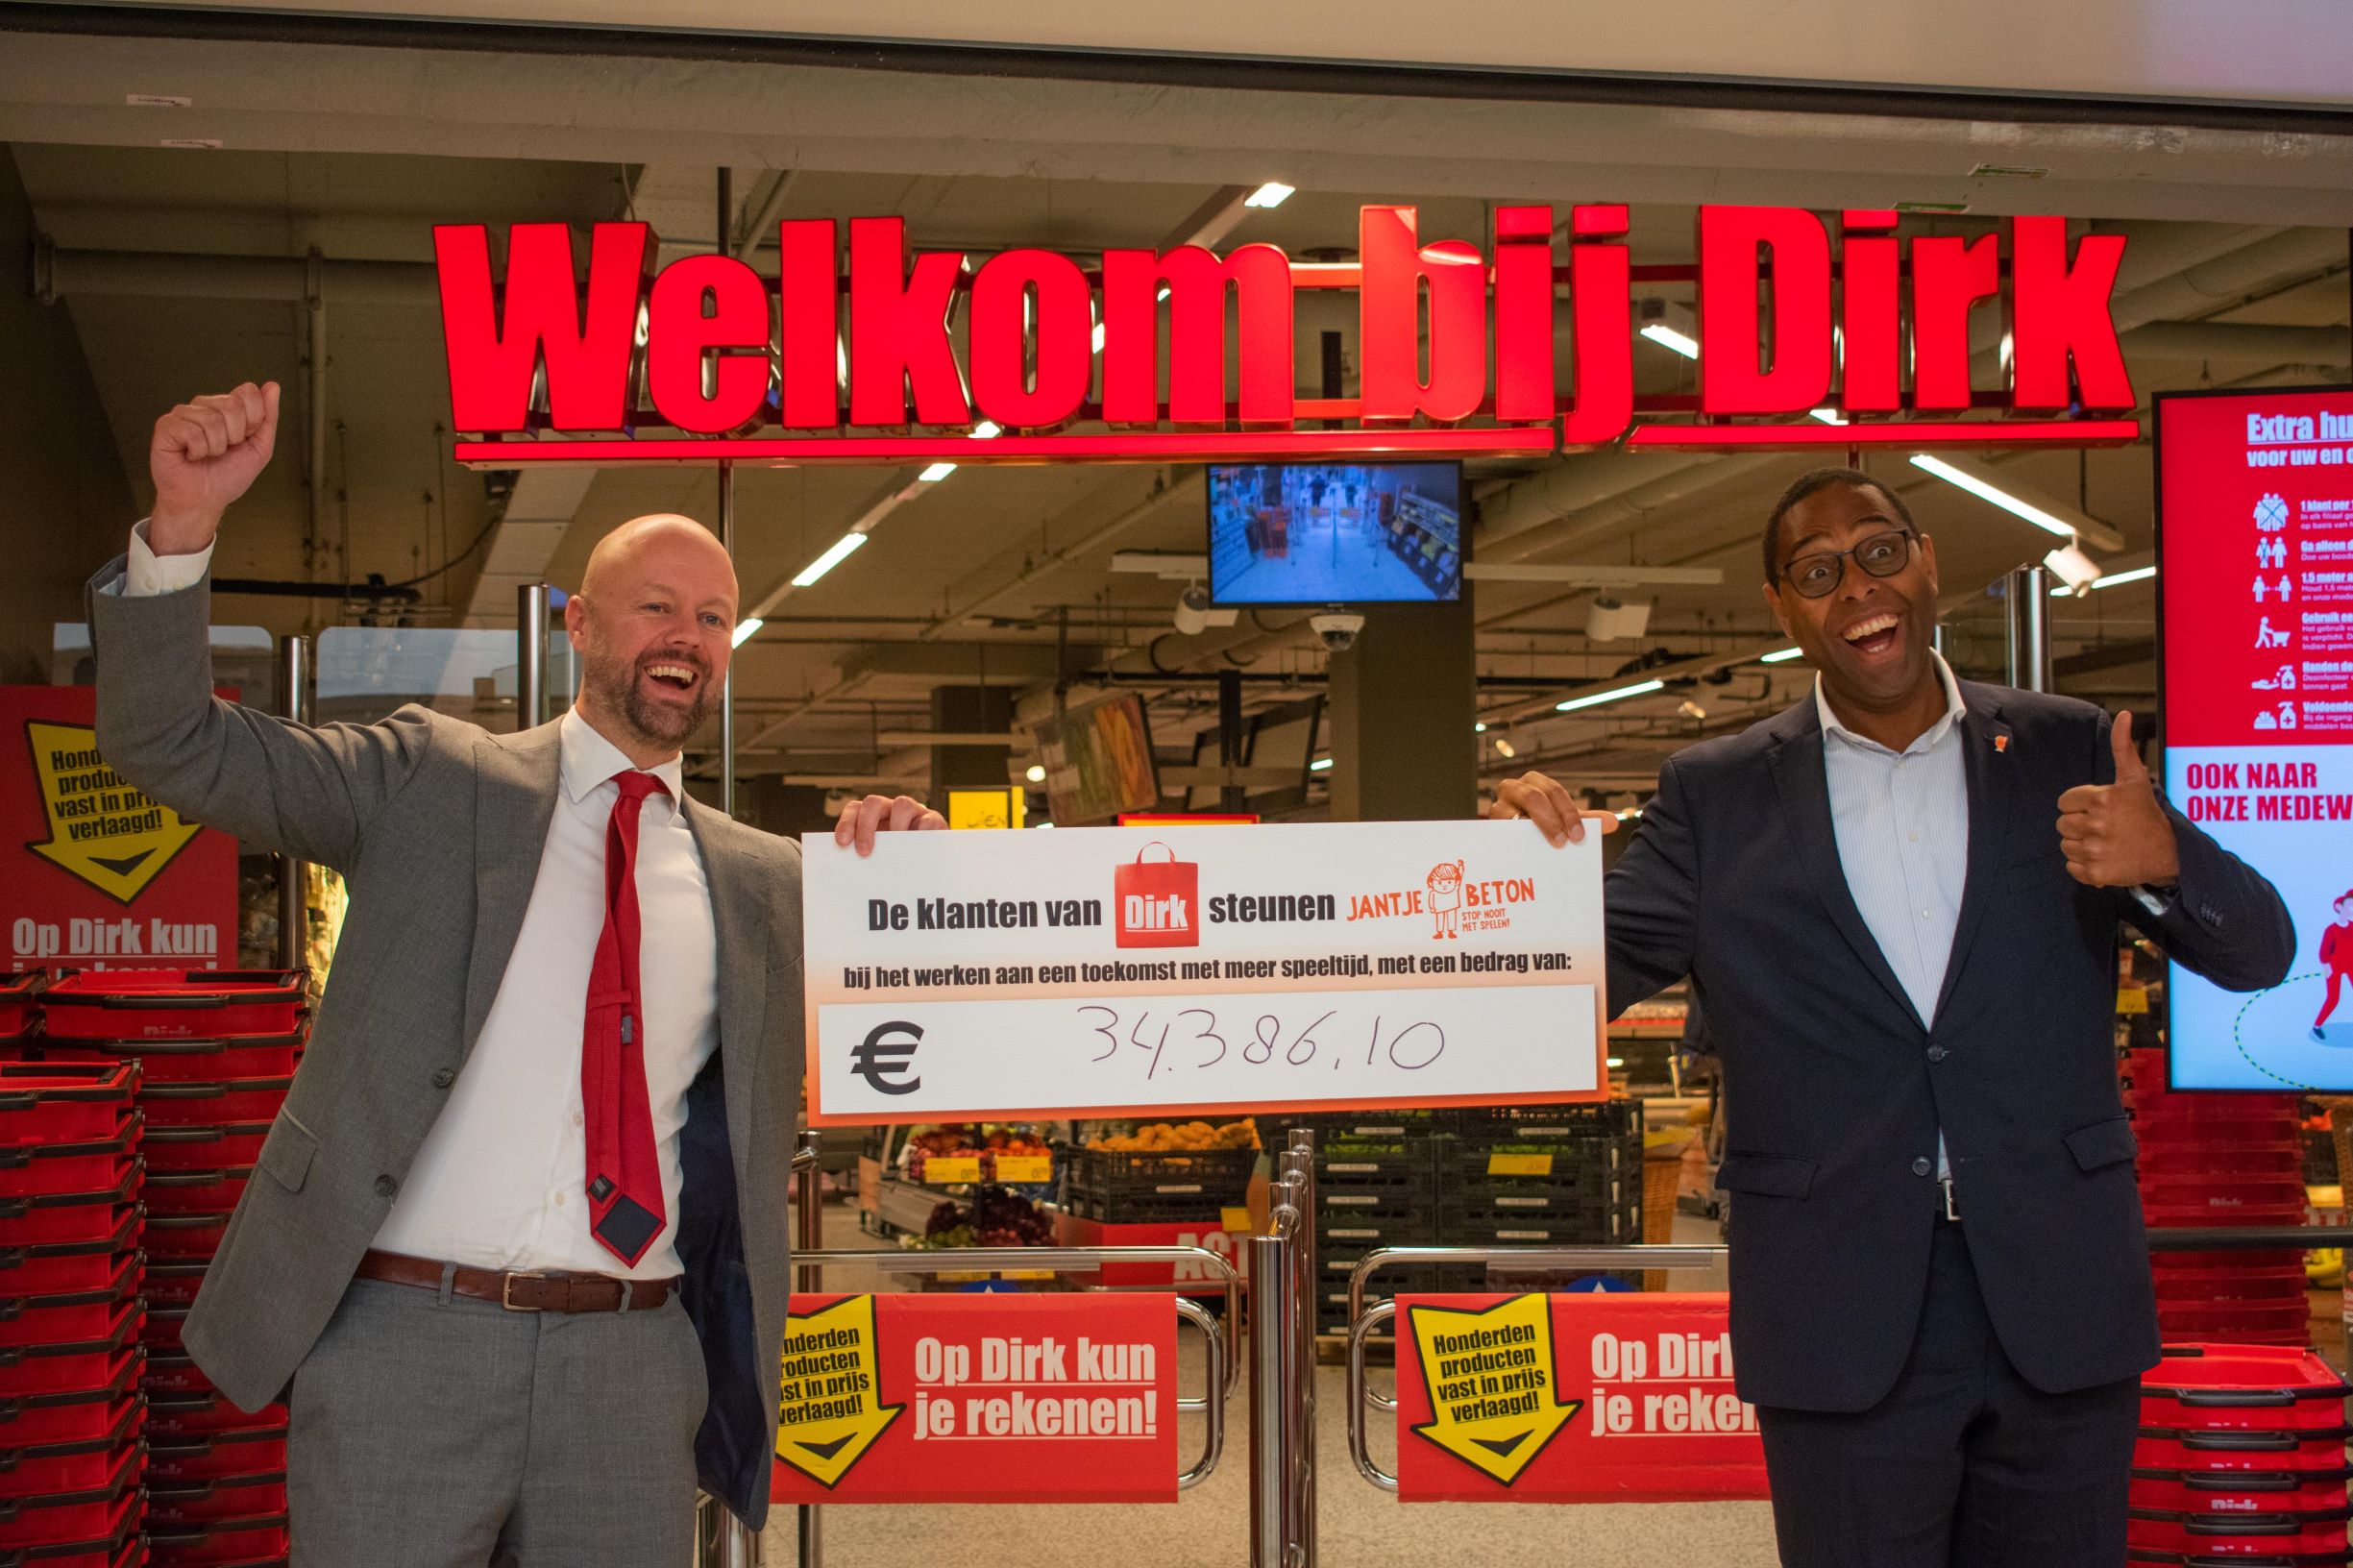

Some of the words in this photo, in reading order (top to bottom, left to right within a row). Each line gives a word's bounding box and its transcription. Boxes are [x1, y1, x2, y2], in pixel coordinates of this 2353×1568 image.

[432, 216, 1294, 434] Welkom
[1360, 204, 1633, 446] bij
[1700, 204, 2137, 415] Dirk
[2246, 412, 2315, 444] Extra
[2246, 449, 2288, 467] voor
[2291, 448, 2317, 465] uw
[2319, 447, 2343, 464] en
[2302, 611, 2340, 624] Gebruik
[2302, 661, 2340, 674] Handen
[2187, 763, 2239, 790] OOK
[2246, 762, 2317, 789] NAAR
[54, 796, 97, 818] vast
[100, 793, 120, 812] in
[2188, 796, 2248, 821] ONZE
[2256, 794, 2353, 821] MEDEW
[68, 809, 162, 841] verlaagd!
[869, 898, 909, 931] De
[917, 897, 1038, 930] klanten
[1044, 898, 1102, 927] van
[1124, 894, 1189, 931] Dirk
[1209, 893, 1336, 923] steunen
[1346, 890, 1423, 921] JANTJE
[1465, 877, 1535, 907] BETON
[1461, 911, 1481, 920] STOP
[1483, 908, 1507, 919] NOOIT
[12, 918, 60, 958] Op
[69, 918, 142, 955] Dirk
[151, 919, 217, 954] kun
[1462, 922, 1477, 931] MET
[1481, 918, 1510, 930] SPELEN!
[844, 967, 870, 991] bij
[875, 966, 910, 988] het
[915, 965, 991, 987] werken
[995, 967, 1034, 985] aan
[1039, 965, 1077, 983] een
[1081, 961, 1177, 982] toekomst
[1181, 959, 1220, 980] met
[1225, 959, 1277, 979] meer
[1281, 955, 1374, 980] speeltijd,
[1378, 954, 1415, 975] met
[1420, 954, 1457, 974] een
[1460, 951, 1529, 974] bedrag
[1532, 952, 1573, 971] van:
[849, 1020, 925, 1096] €
[1077, 1005, 1445, 1081] 34.386,10
[1173, 1231, 1249, 1280] ACT
[783, 1328, 860, 1354] nderden
[1433, 1324, 1536, 1355] Honderden
[915, 1337, 969, 1385] Op
[981, 1337, 1066, 1382] Dirk
[1077, 1337, 1155, 1382] kun
[1440, 1346, 1536, 1378] producten
[1591, 1333, 1647, 1383] Op
[781, 1382, 801, 1401] st
[805, 1379, 823, 1397] in
[826, 1372, 870, 1396] prijs
[1437, 1381, 1477, 1401] vast
[1481, 1375, 1500, 1395] in
[1503, 1368, 1546, 1394] prijs
[914, 1391, 955, 1439] je
[967, 1390, 1157, 1435] rekenen!
[1451, 1391, 1540, 1422] verlaagd!
[1591, 1387, 1632, 1436] je
